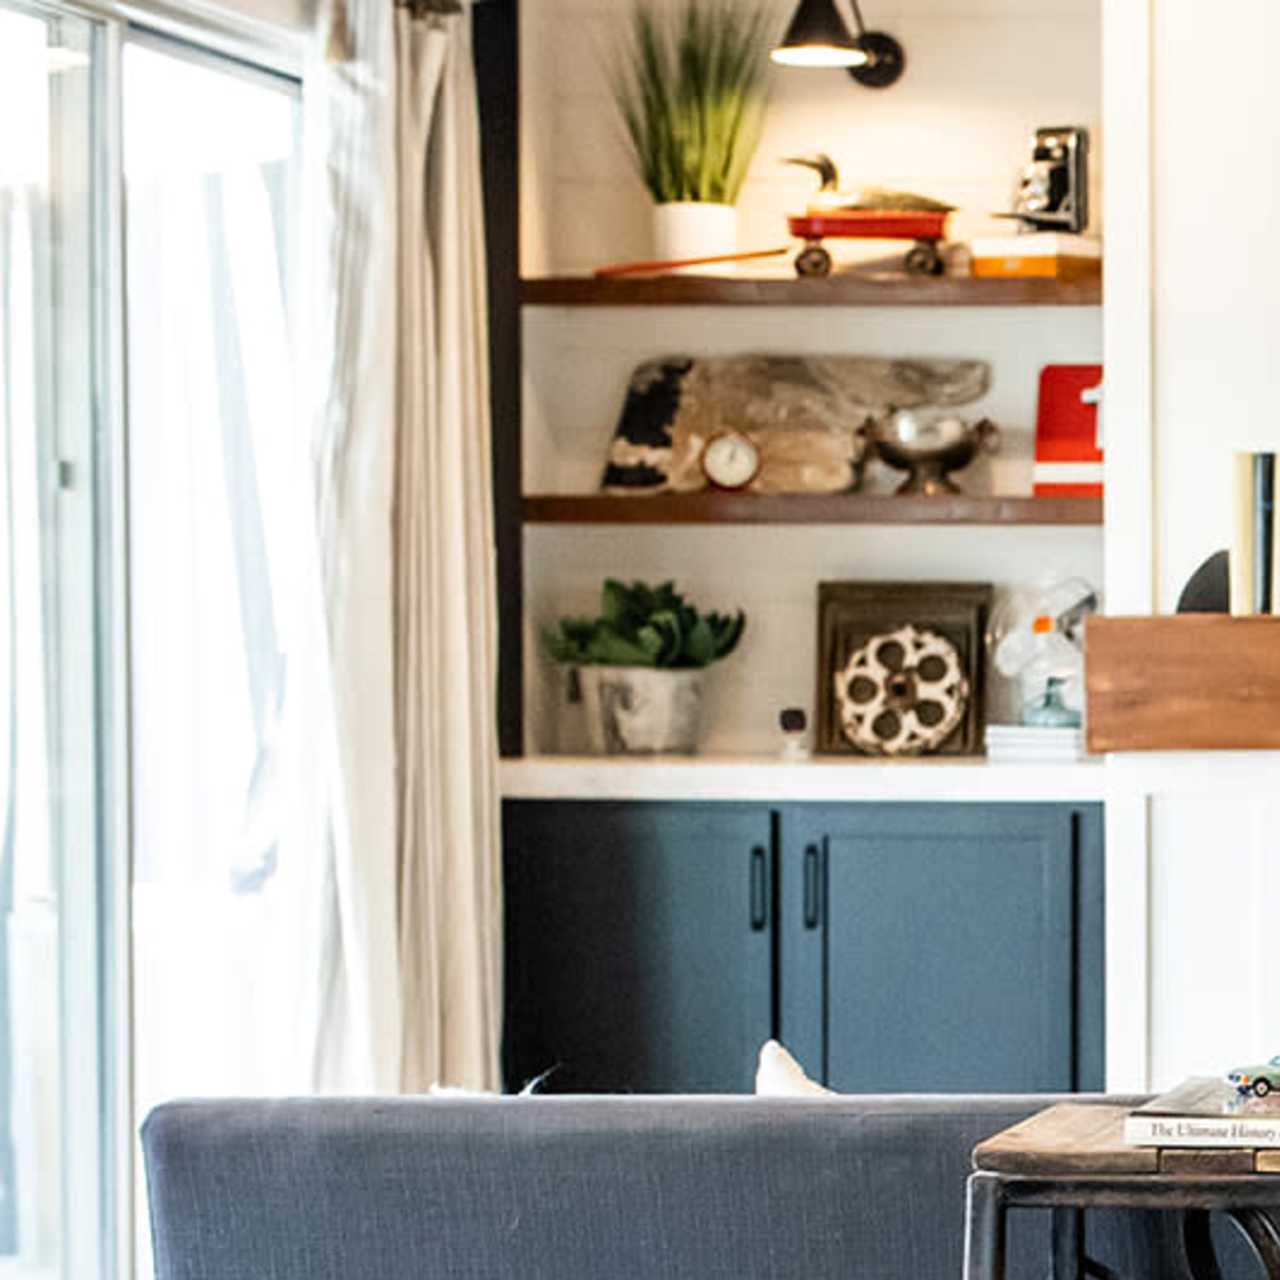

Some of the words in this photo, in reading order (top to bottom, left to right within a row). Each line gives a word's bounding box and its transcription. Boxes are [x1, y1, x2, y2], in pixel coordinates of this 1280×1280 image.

[1151, 1122, 1173, 1138] The
[1177, 1122, 1228, 1138] Ultimate
[1231, 1122, 1276, 1143] History
